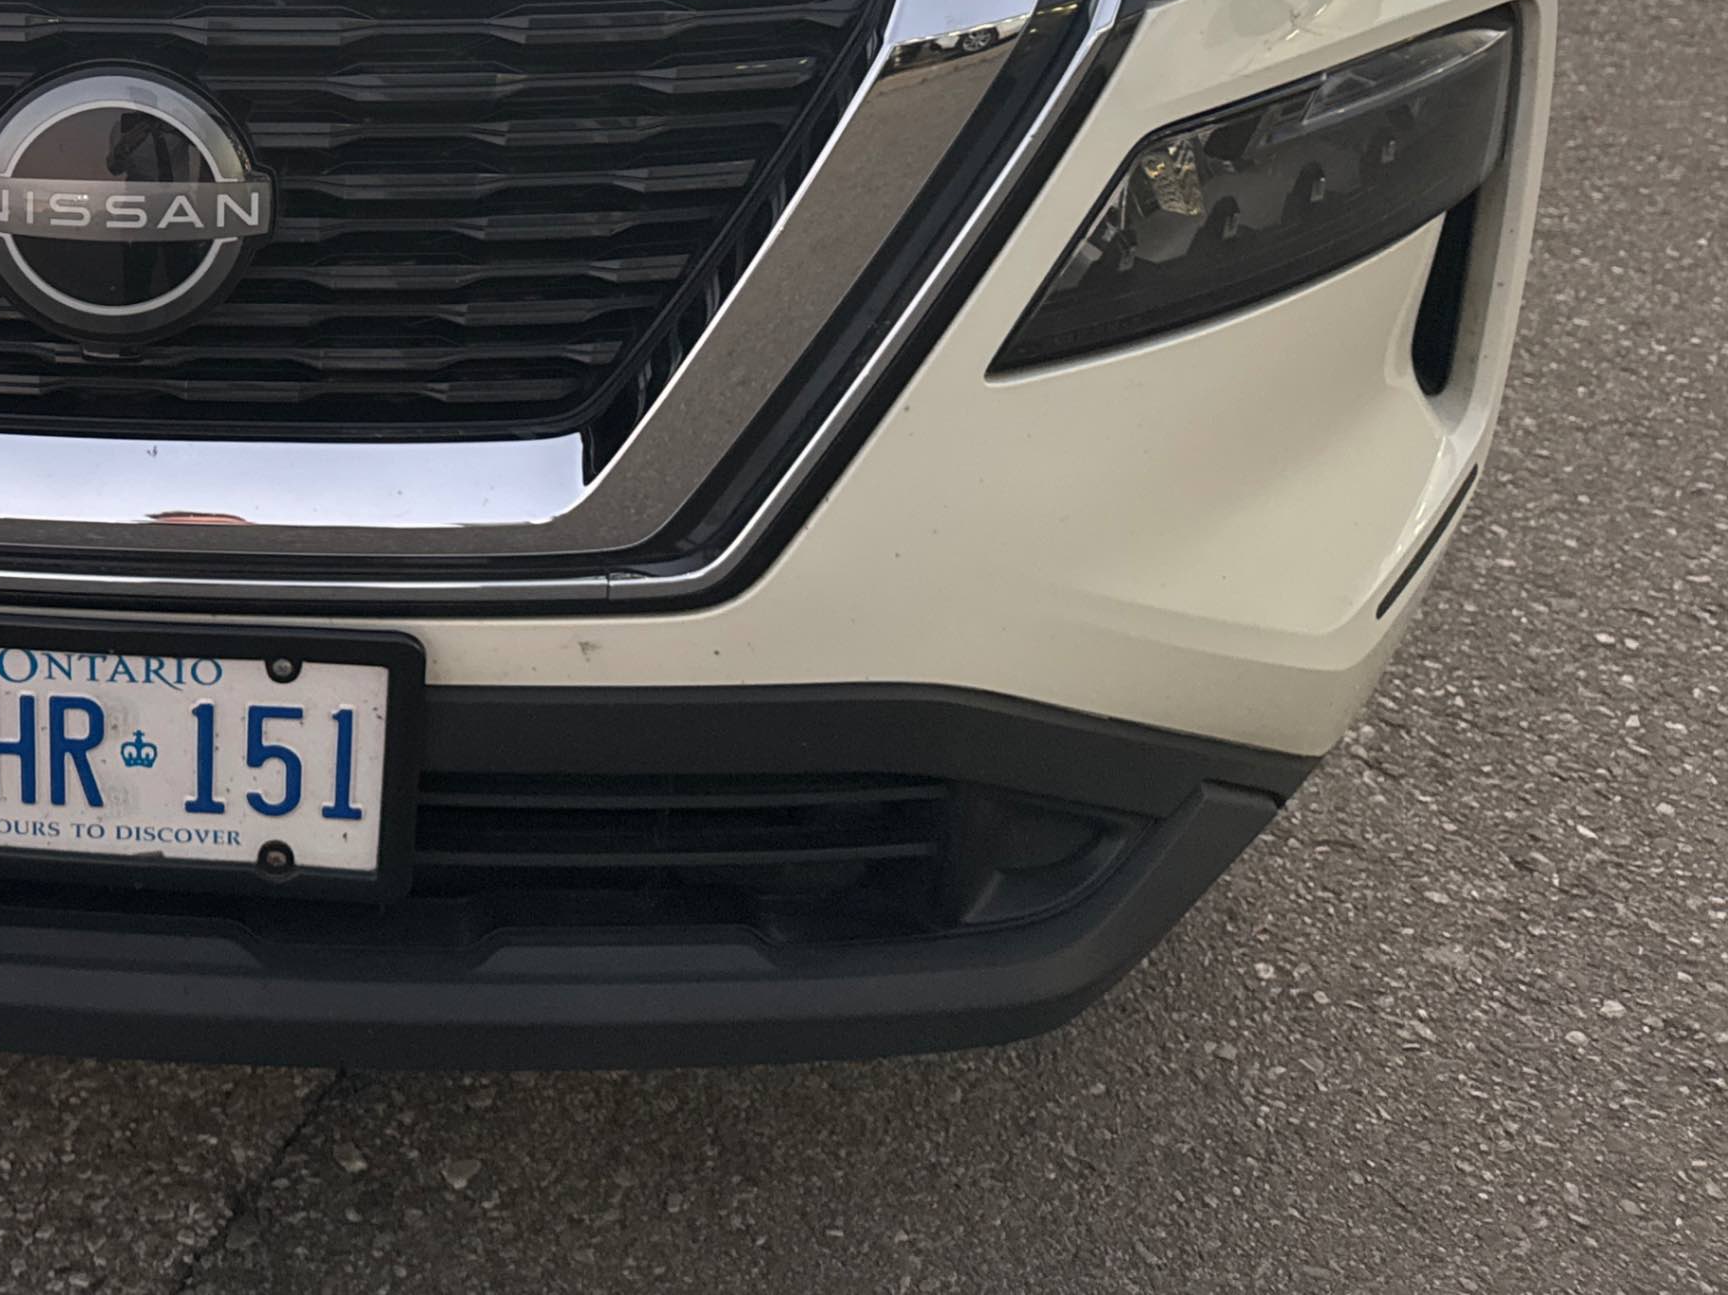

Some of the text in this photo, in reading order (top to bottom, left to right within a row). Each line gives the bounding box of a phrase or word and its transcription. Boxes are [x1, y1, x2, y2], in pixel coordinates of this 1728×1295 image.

[185, 703, 362, 820] 151
[72, 823, 105, 839] TO
[115, 825, 241, 847] DISCOVER
